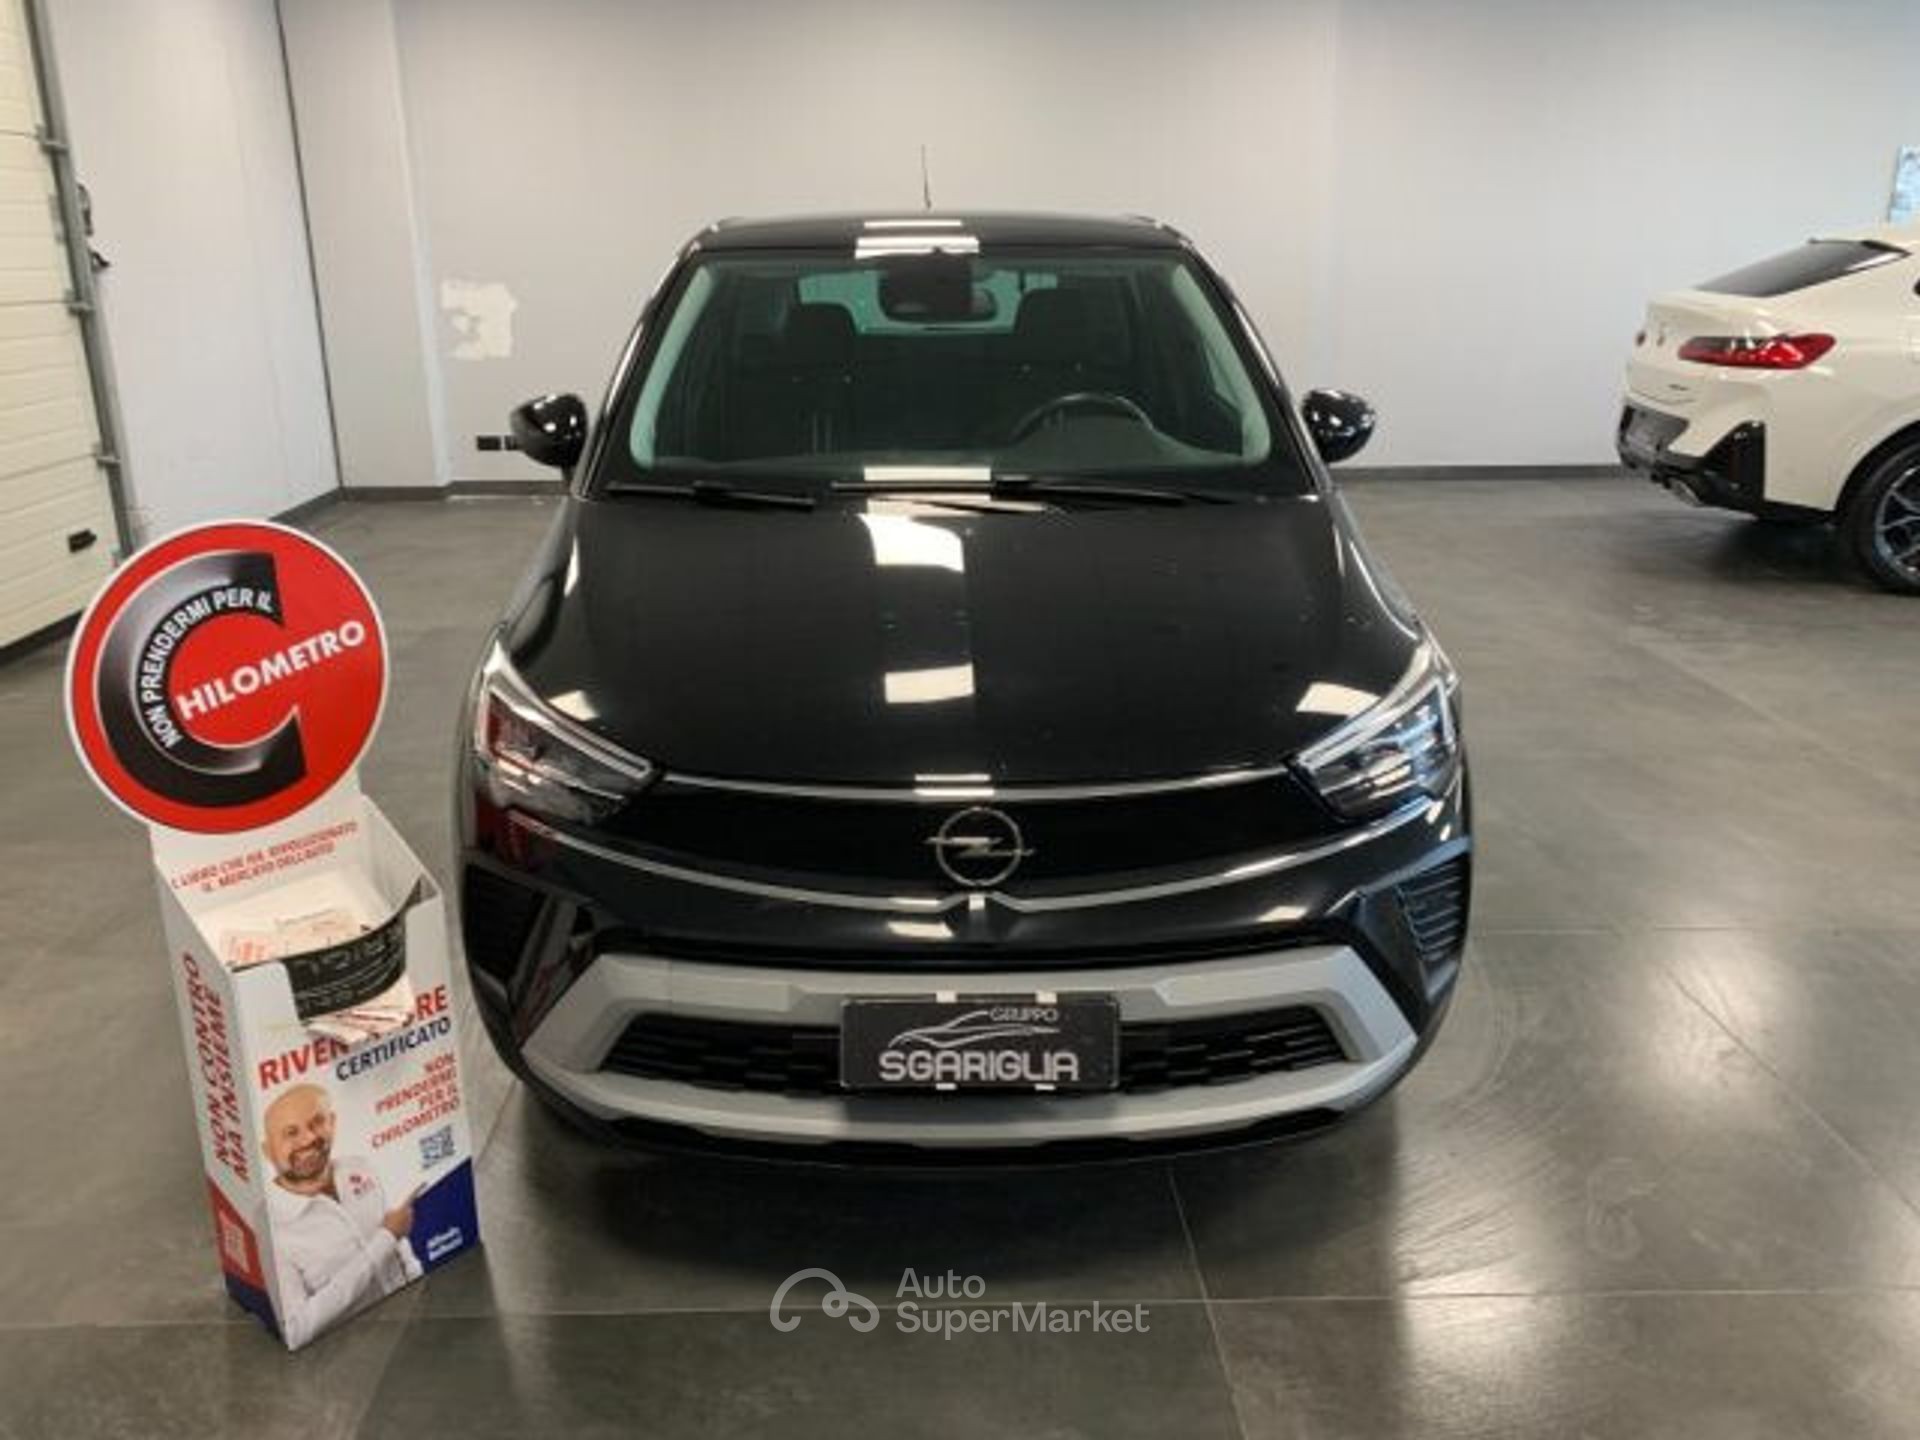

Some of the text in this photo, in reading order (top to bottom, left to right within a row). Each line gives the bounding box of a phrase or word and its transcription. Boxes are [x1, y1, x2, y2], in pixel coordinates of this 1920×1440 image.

[141, 588, 274, 748] NON PRENDERMI PER IL
[176, 620, 366, 721] HILOMETRO
[335, 1016, 451, 1082] CERTIFICATO
[989, 1006, 1059, 1023] GRUPPO
[182, 951, 231, 1167] NON CONTRO
[204, 983, 250, 1184] MA INSIEME
[424, 1052, 456, 1073] NON
[879, 1050, 1079, 1082] SGARIGLIA
